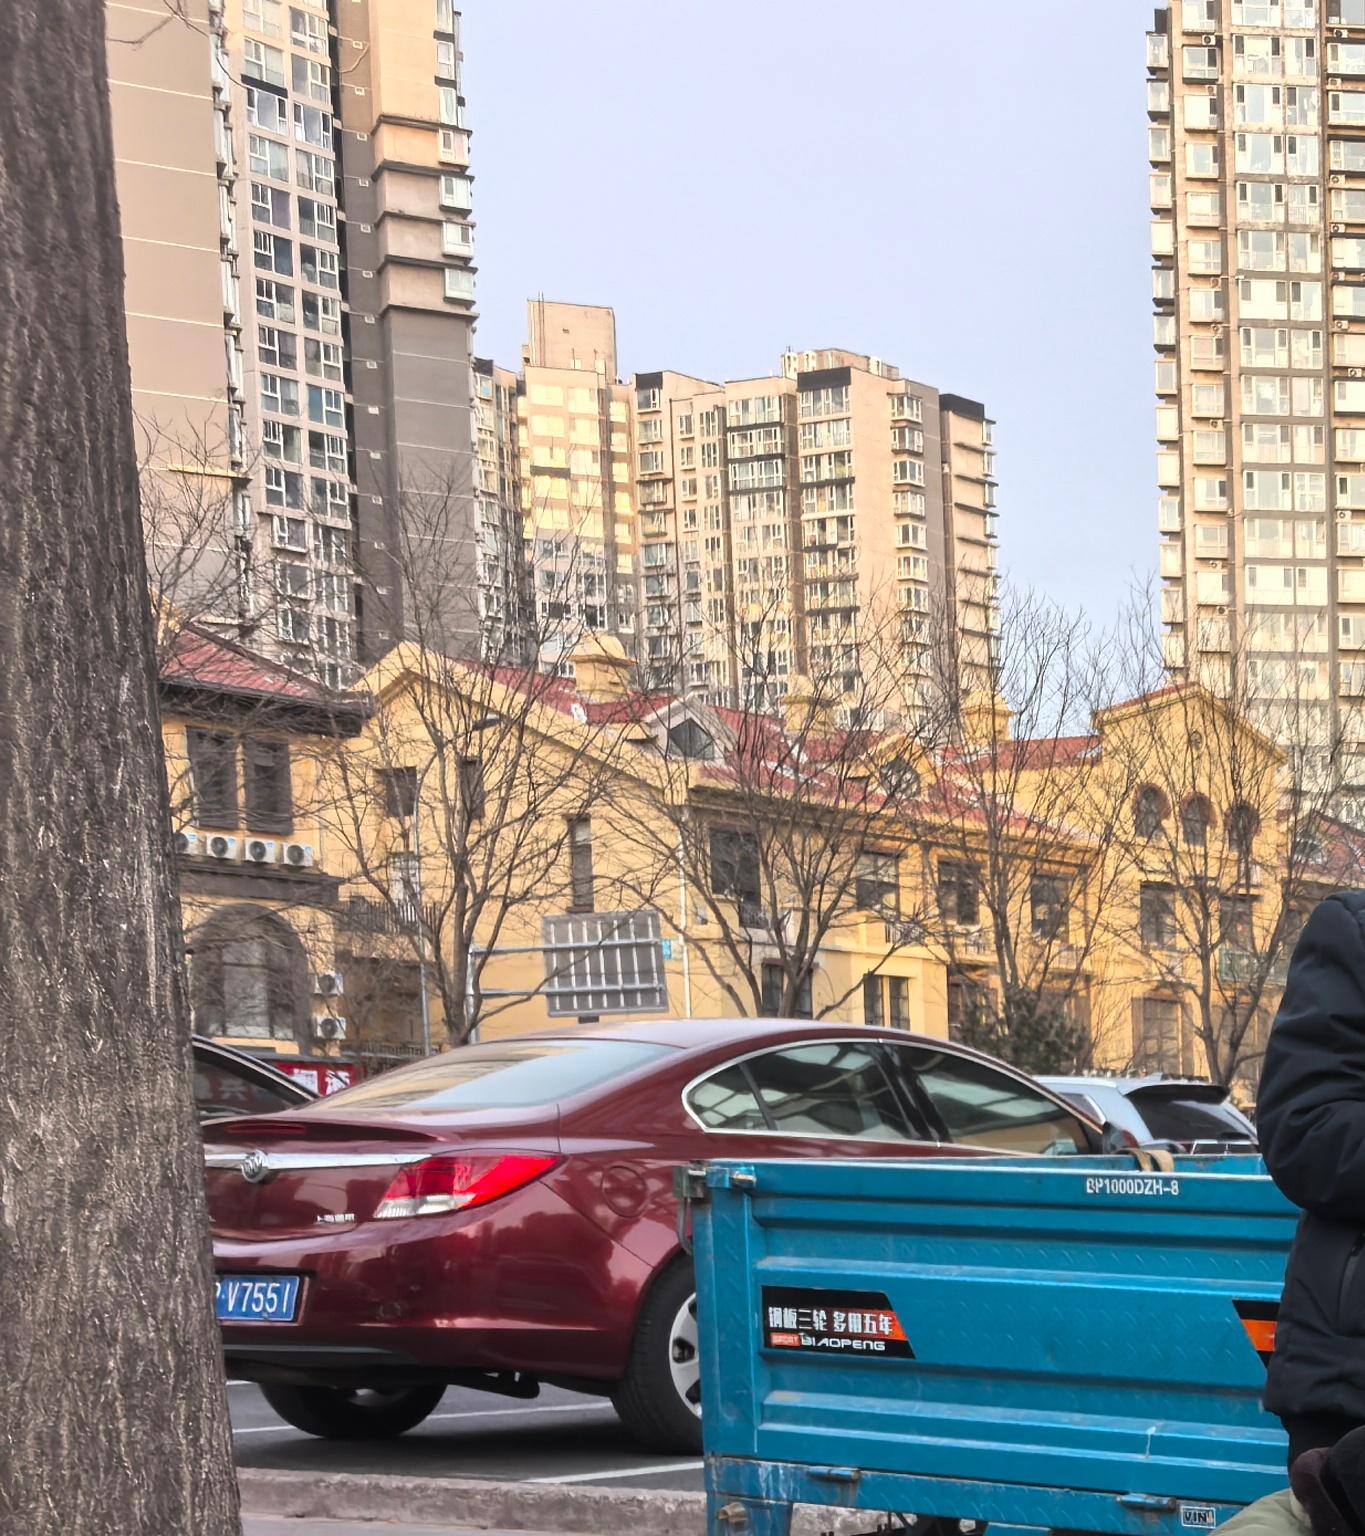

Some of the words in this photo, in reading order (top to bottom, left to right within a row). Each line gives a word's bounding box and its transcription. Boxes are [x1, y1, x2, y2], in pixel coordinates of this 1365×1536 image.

[1085, 1177, 1180, 1196] BP1000DZH-8
[768, 1306, 829, 1332] 钢板三轮
[832, 1310, 893, 1336] 多用五年
[801, 1335, 886, 1351] BIAOPENG
